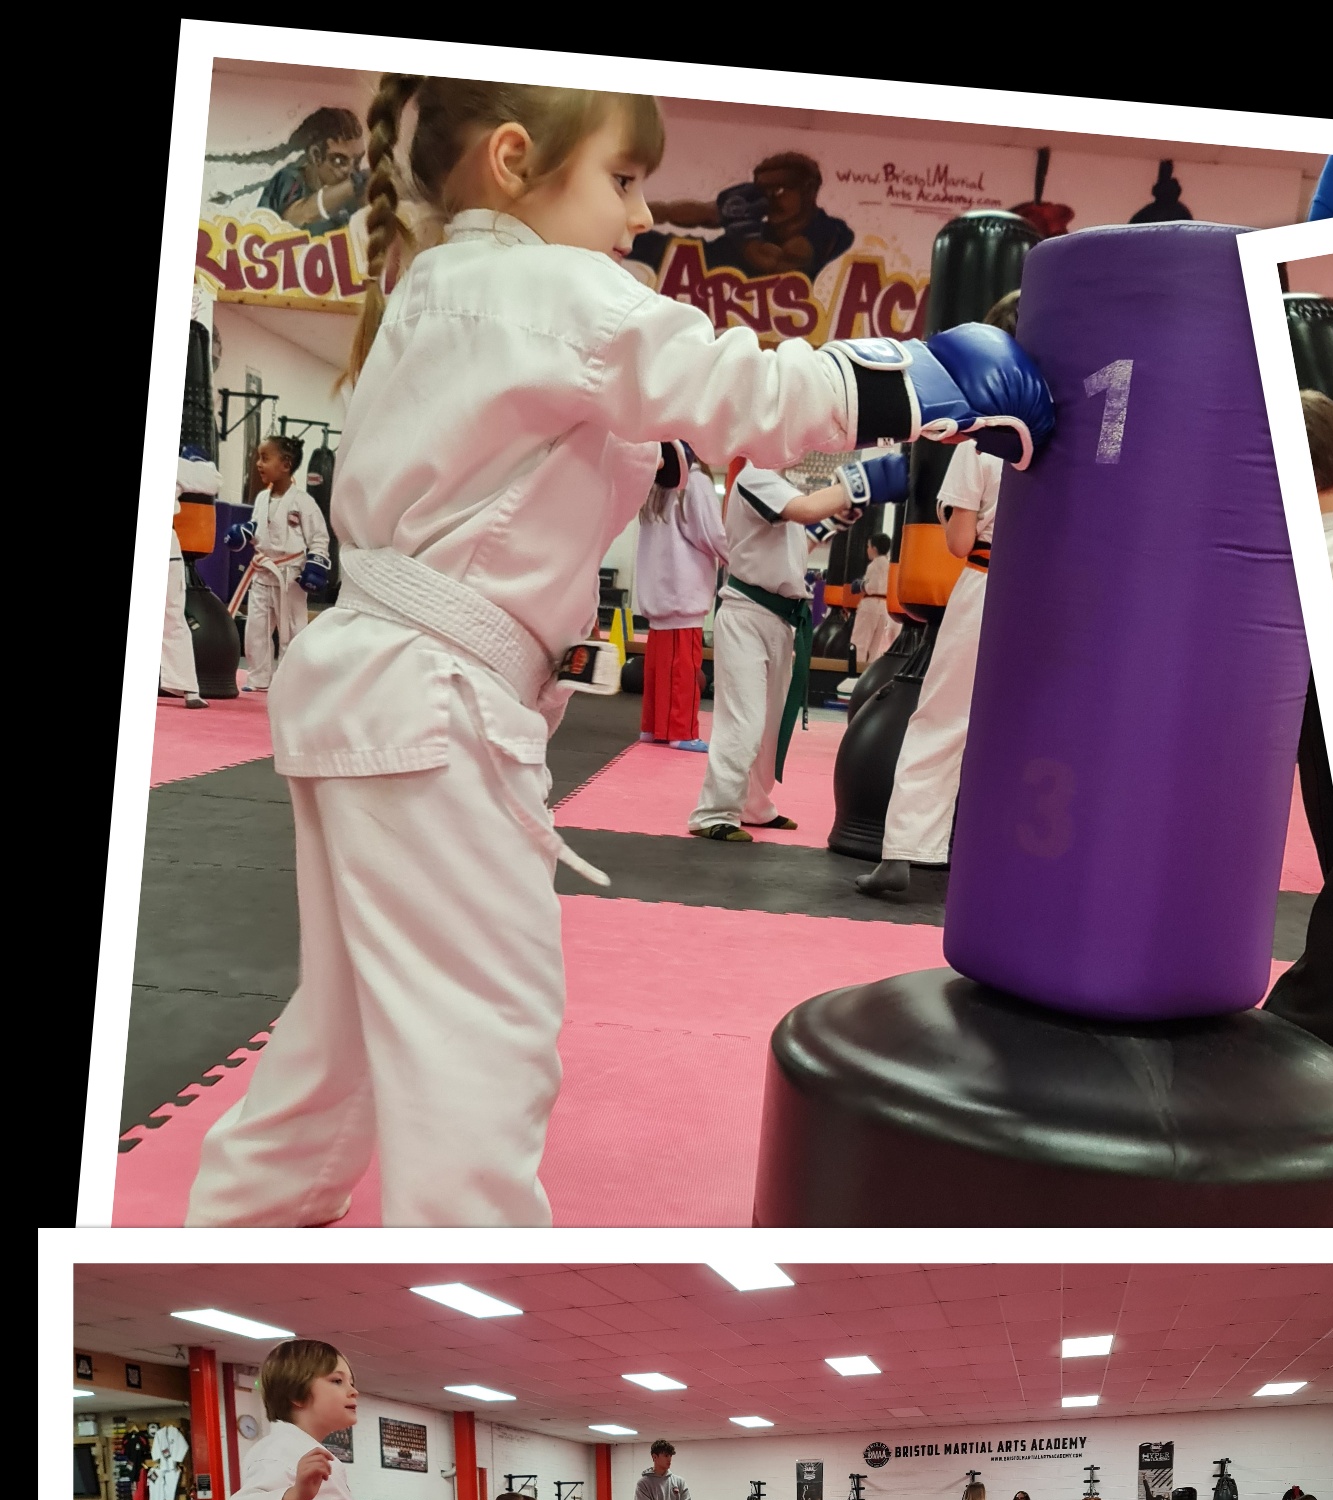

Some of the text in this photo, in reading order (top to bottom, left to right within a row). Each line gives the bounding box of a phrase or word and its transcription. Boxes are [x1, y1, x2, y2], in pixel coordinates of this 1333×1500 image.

[1083, 359, 1134, 465] 1
[1016, 757, 1076, 859] 3
[895, 1436, 1087, 1458] BRISTOL MARTIAL ARTS ACADEMY
